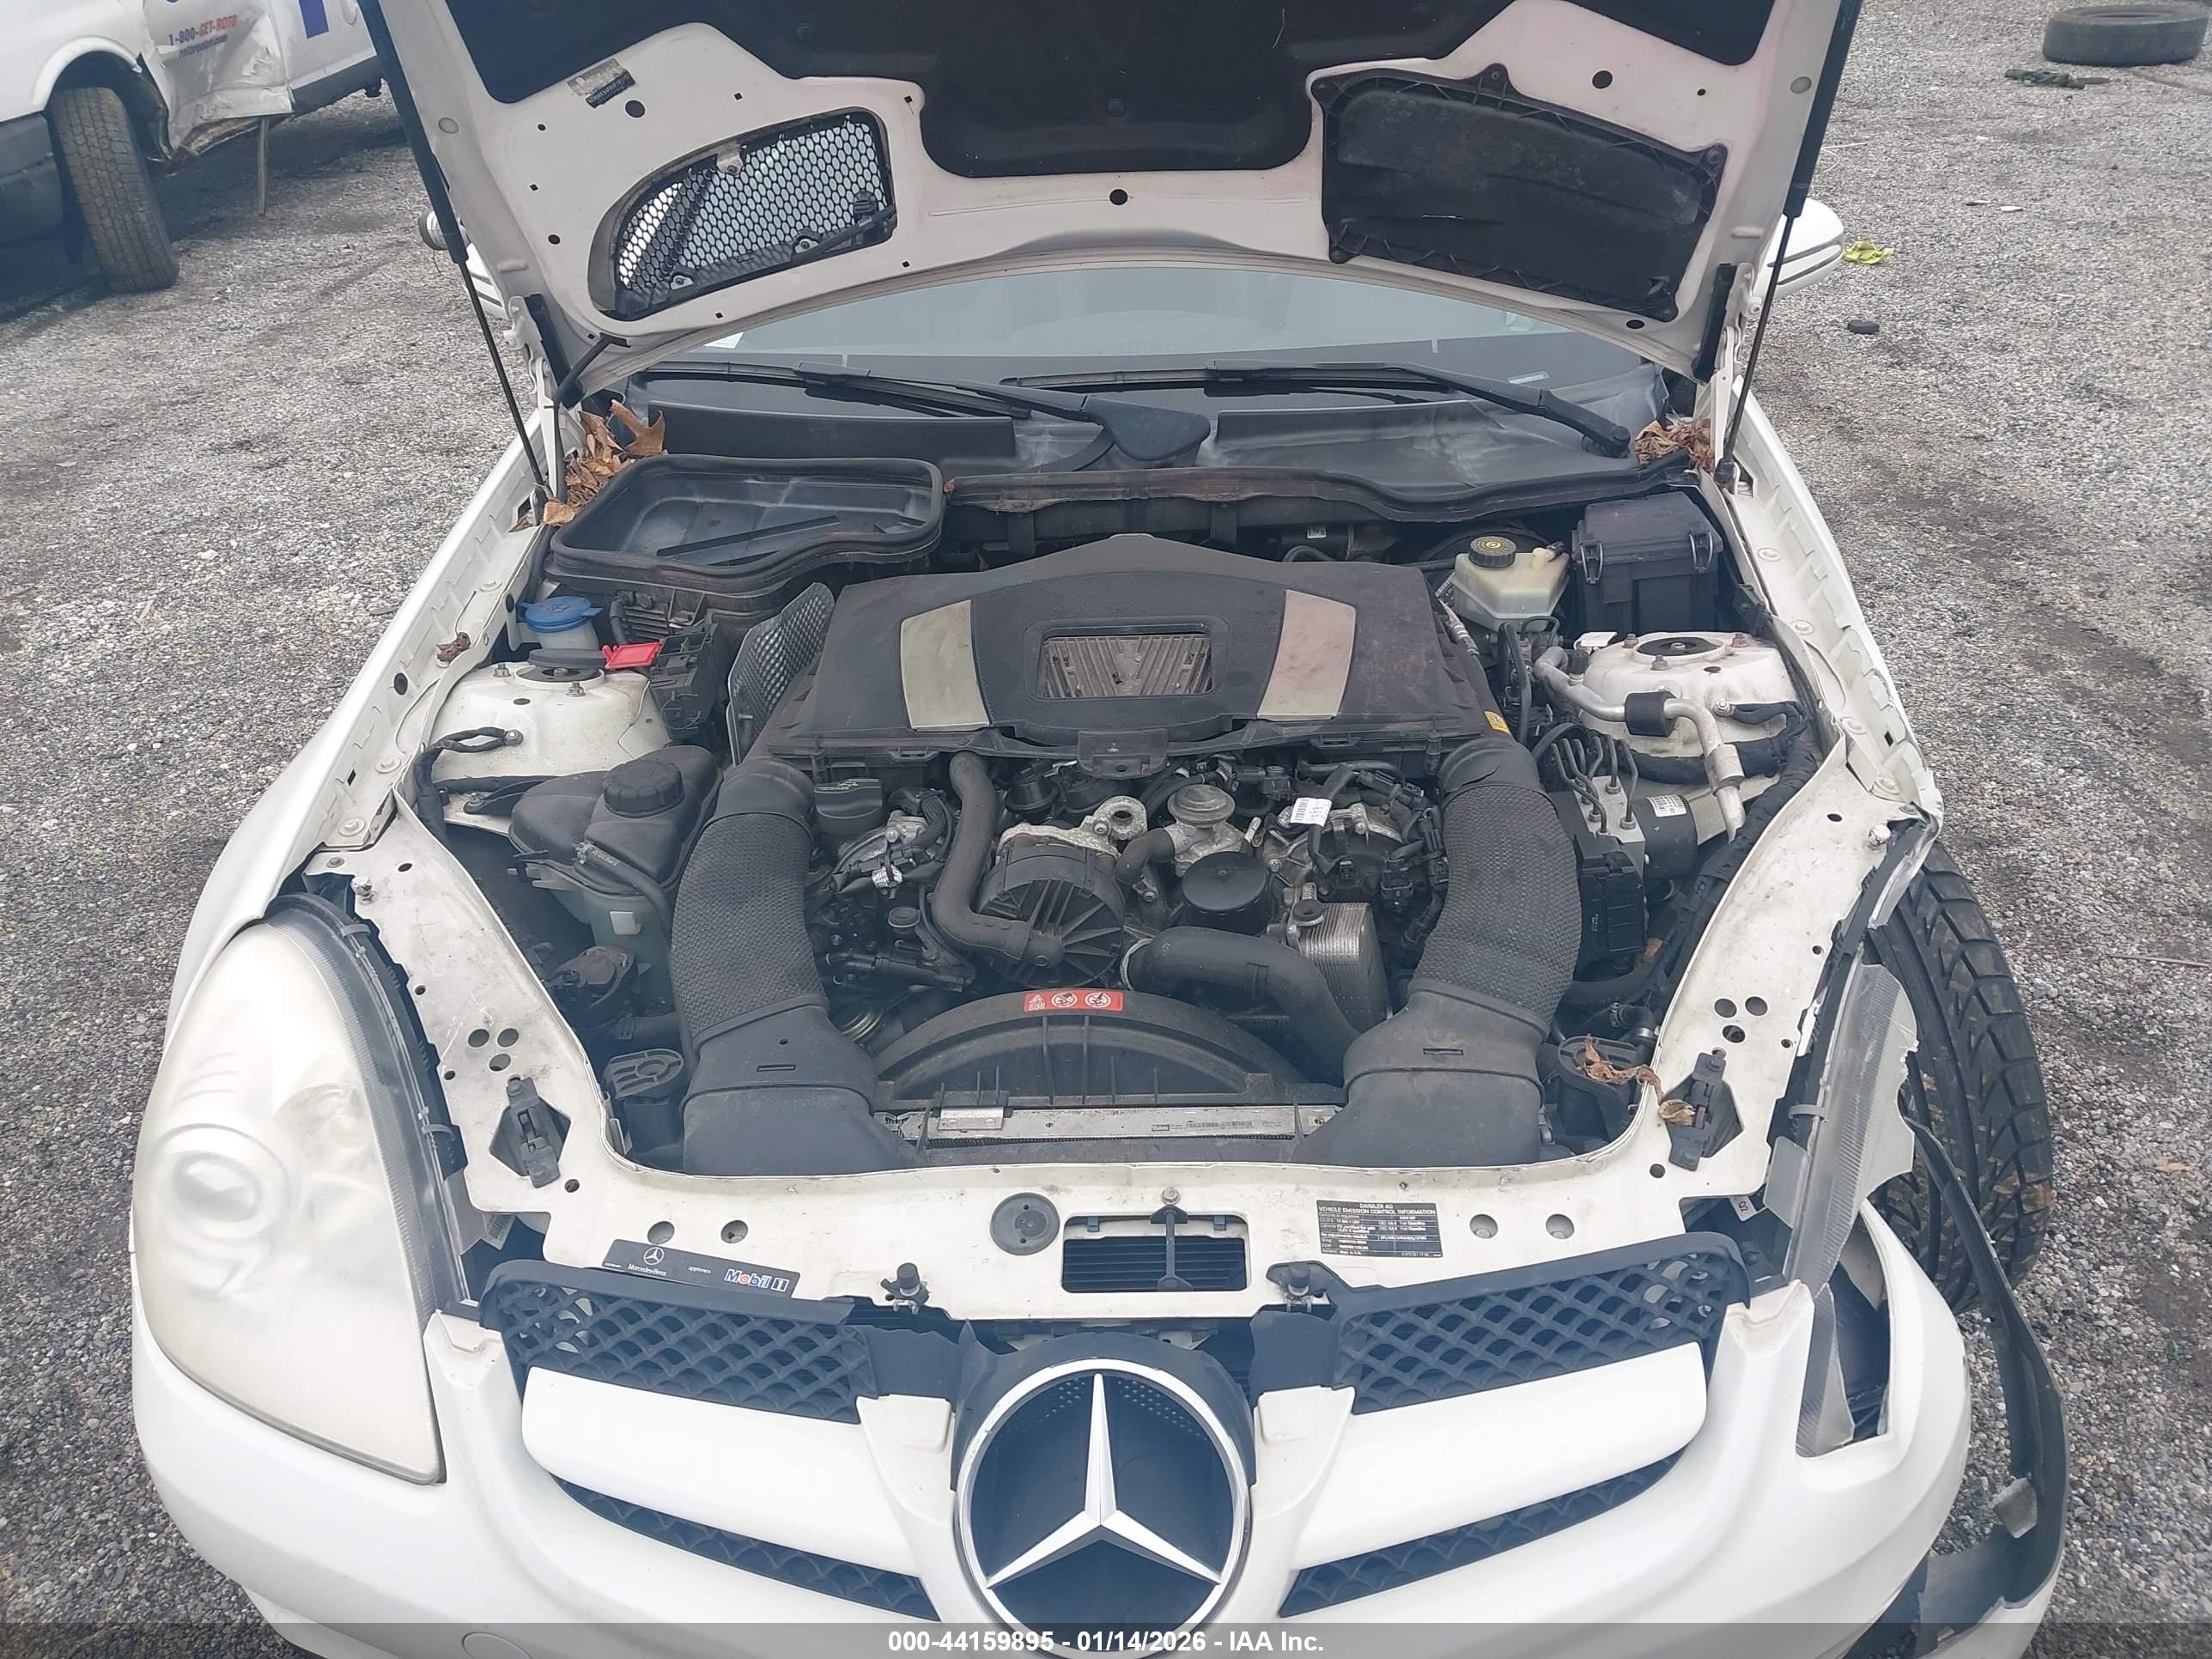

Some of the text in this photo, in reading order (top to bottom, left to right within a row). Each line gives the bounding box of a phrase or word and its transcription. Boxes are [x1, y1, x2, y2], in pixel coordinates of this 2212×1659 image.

[168, 14, 238, 46] 1-800-GET-ROTO
[627, 1263, 666, 1277] Mercedes-Benz
[724, 1269, 772, 1289] Mobil
